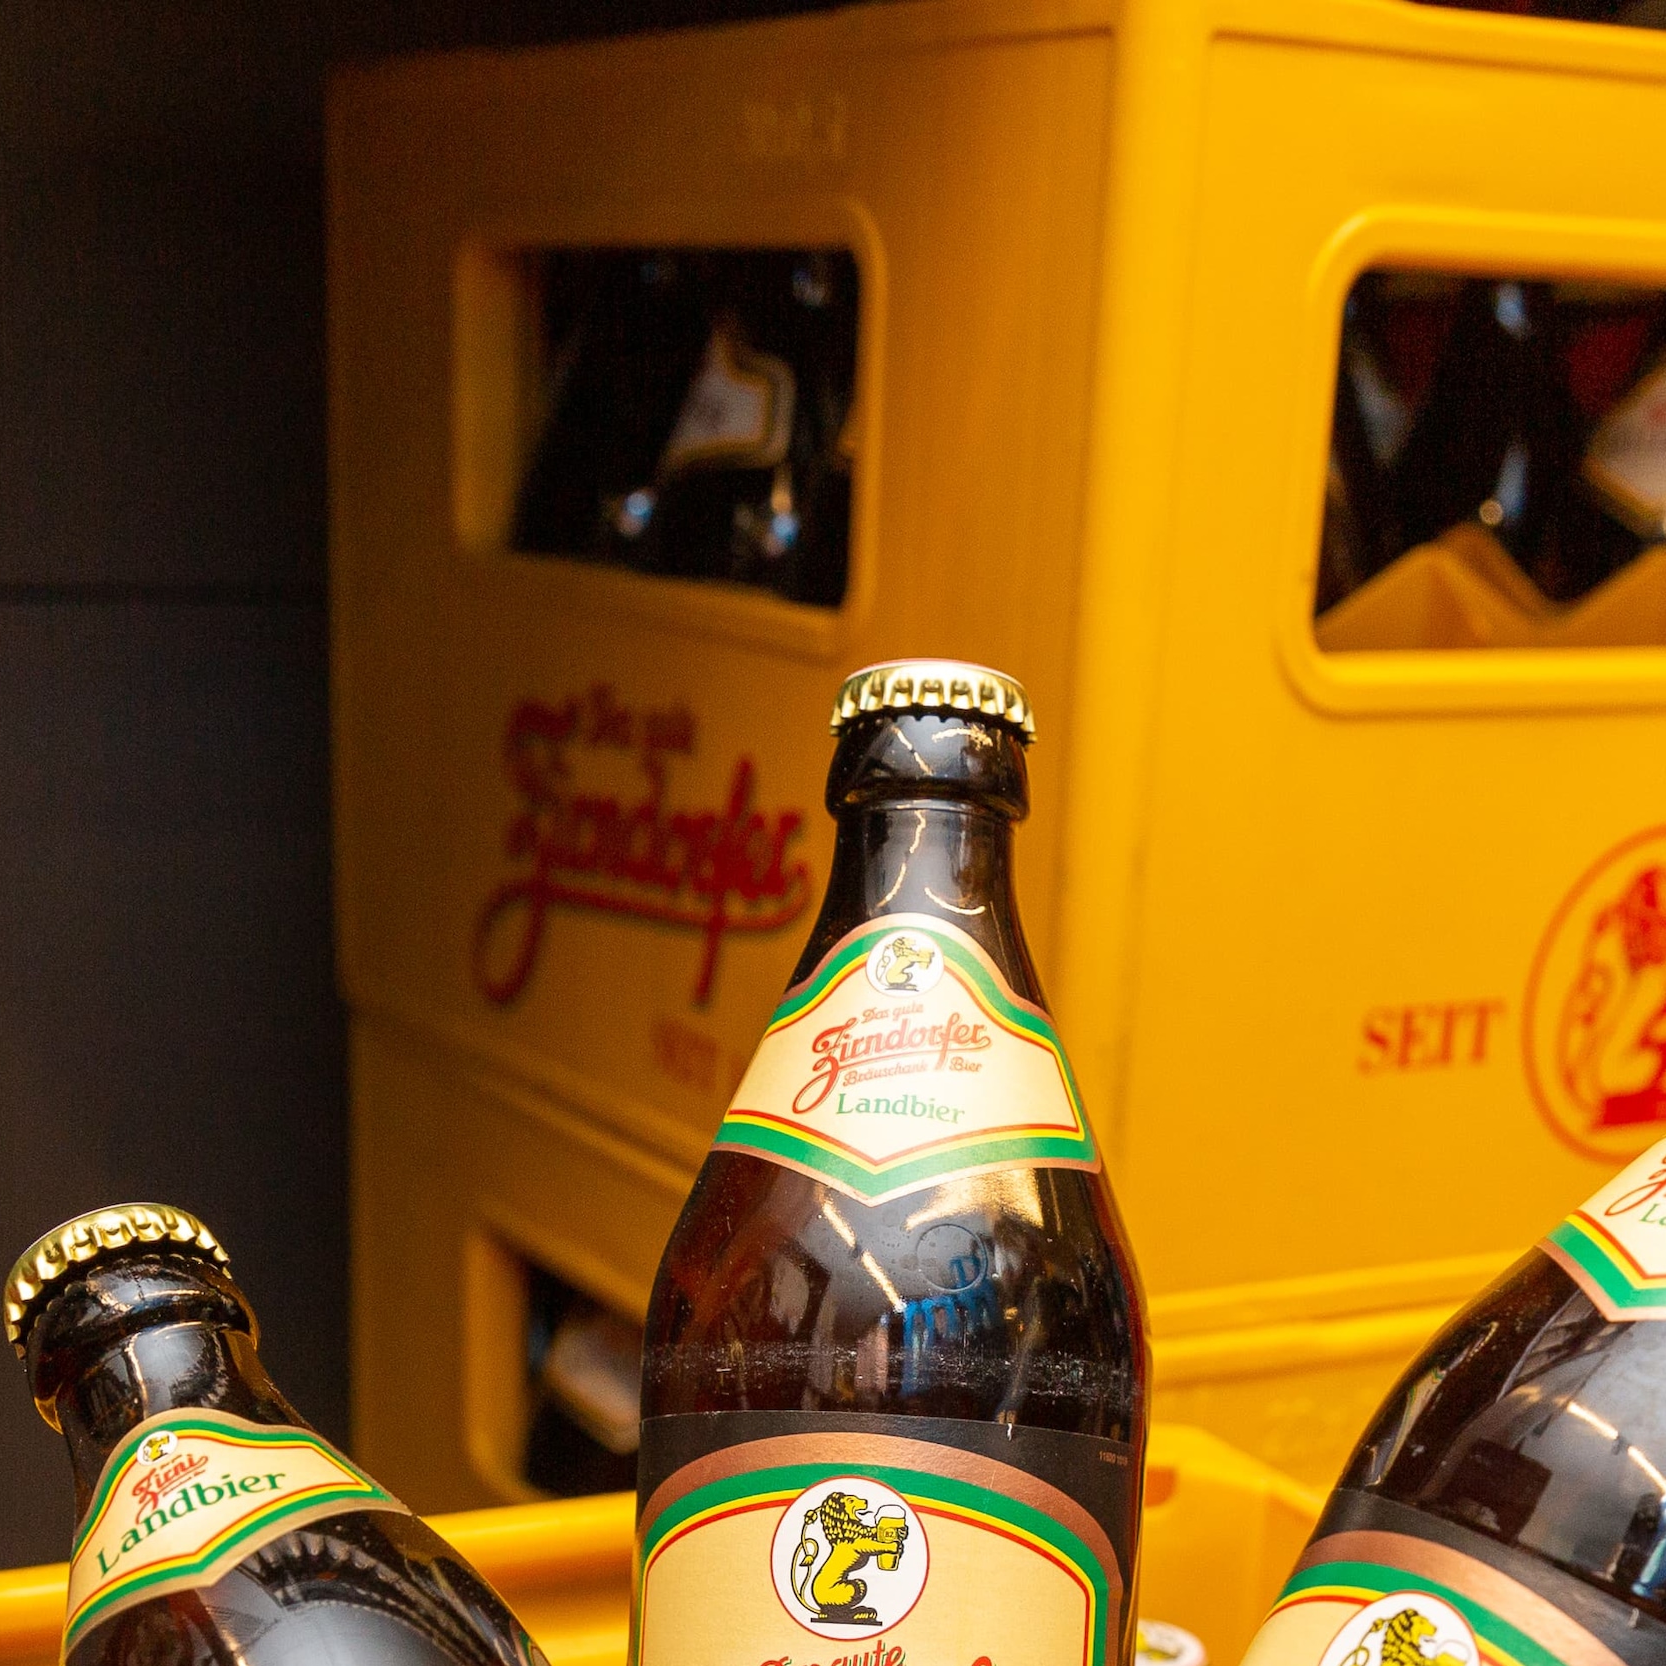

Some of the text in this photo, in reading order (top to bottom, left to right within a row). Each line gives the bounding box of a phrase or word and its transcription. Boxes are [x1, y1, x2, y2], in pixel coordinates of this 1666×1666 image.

[792, 1012, 992, 1114] Zirndorfer
[843, 1056, 982, 1086] Bräuschank Bier
[1357, 997, 1507, 1076] SEIT
[836, 1093, 965, 1124] Landbier
[95, 1470, 287, 1578] Landbier
